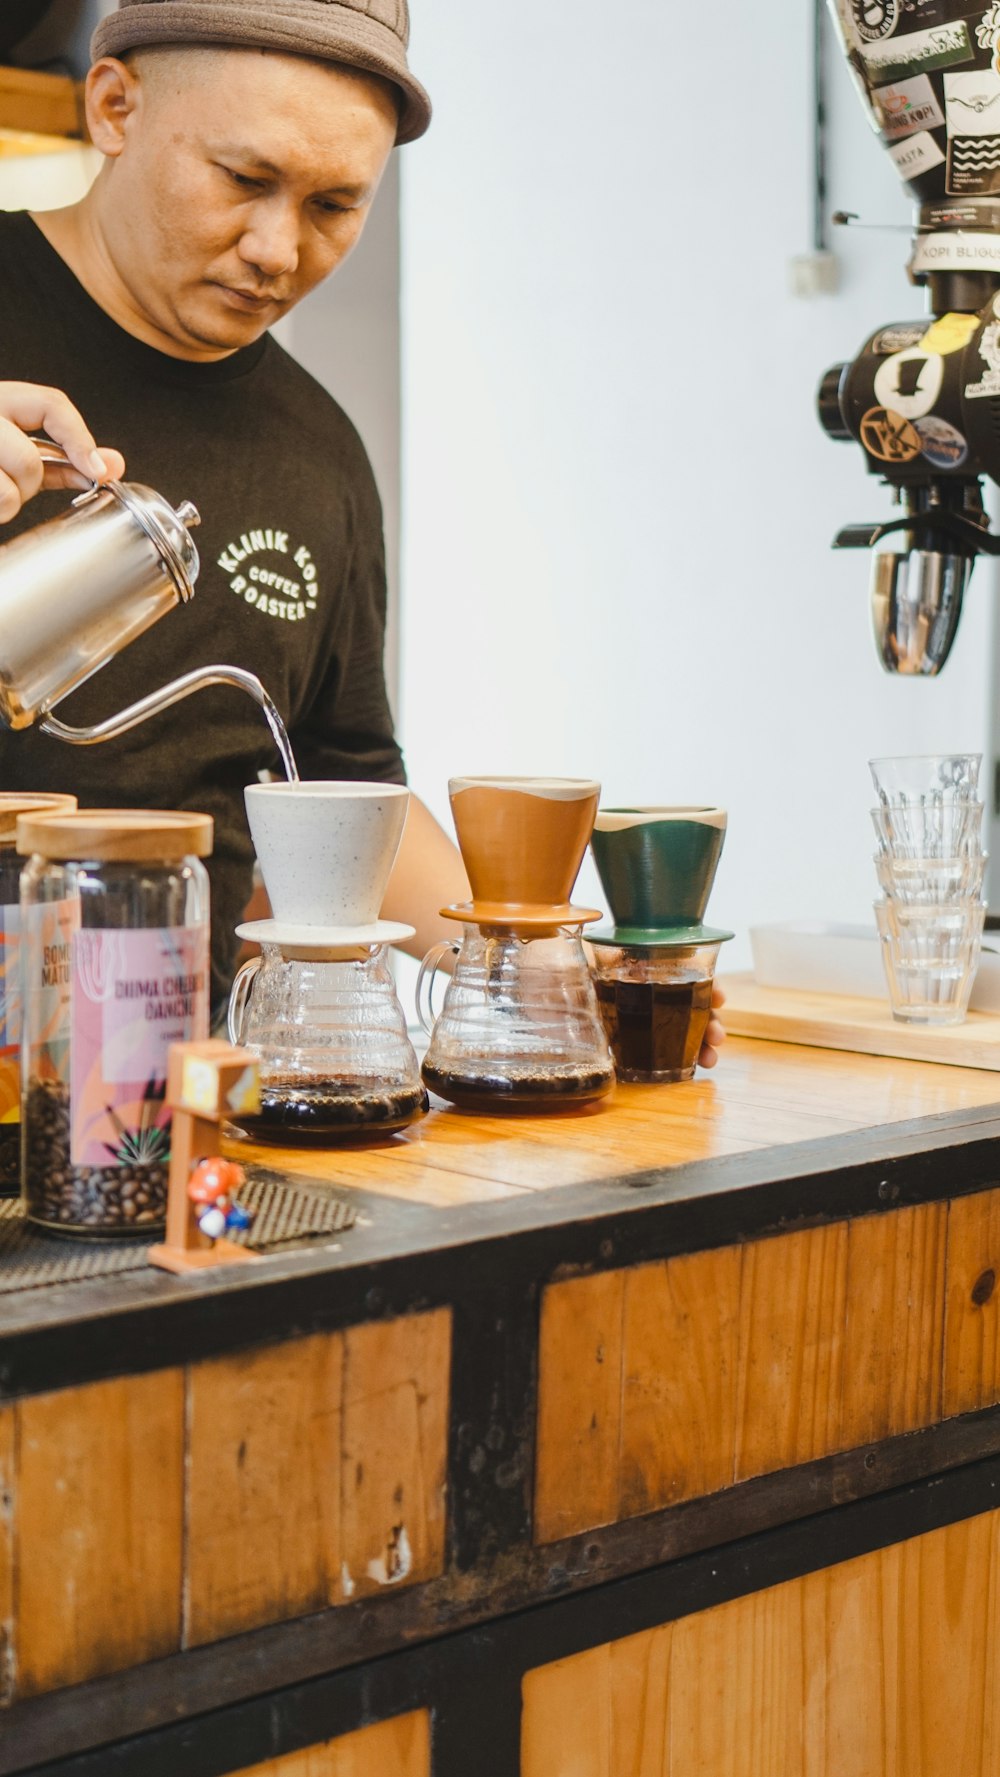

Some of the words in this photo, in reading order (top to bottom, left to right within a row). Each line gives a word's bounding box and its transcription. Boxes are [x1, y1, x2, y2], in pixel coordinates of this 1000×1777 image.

[908, 105, 935, 123] KOPI
[921, 246, 949, 258] KOPI
[217, 528, 289, 573] KLINIK
[293, 545, 318, 610] KOPI
[248, 565, 300, 599] COFFEE
